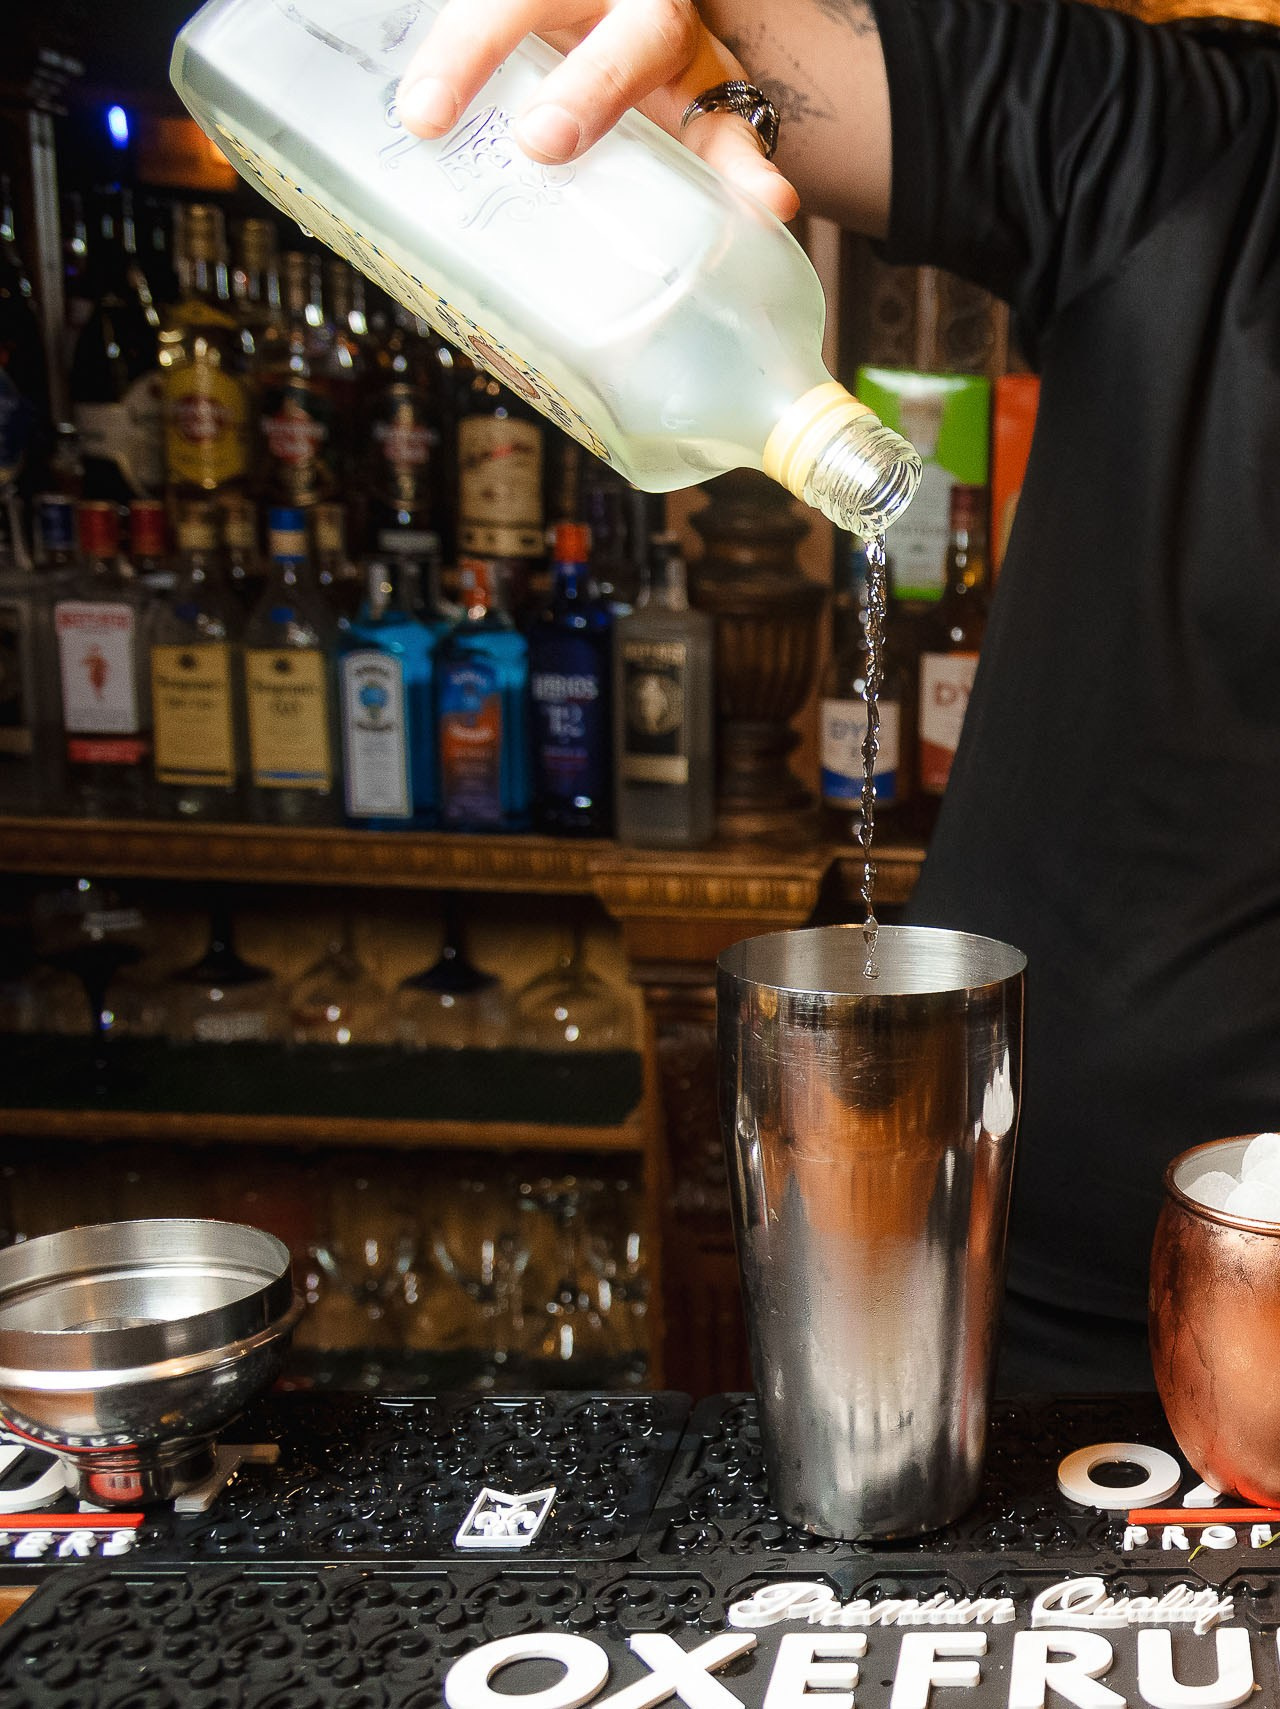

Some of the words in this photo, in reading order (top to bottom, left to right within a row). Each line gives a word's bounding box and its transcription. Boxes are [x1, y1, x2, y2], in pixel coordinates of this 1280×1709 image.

[0, 1530, 136, 1558] ERS
[728, 1582, 1015, 1628] Premium
[1031, 1576, 1235, 1636] Quality
